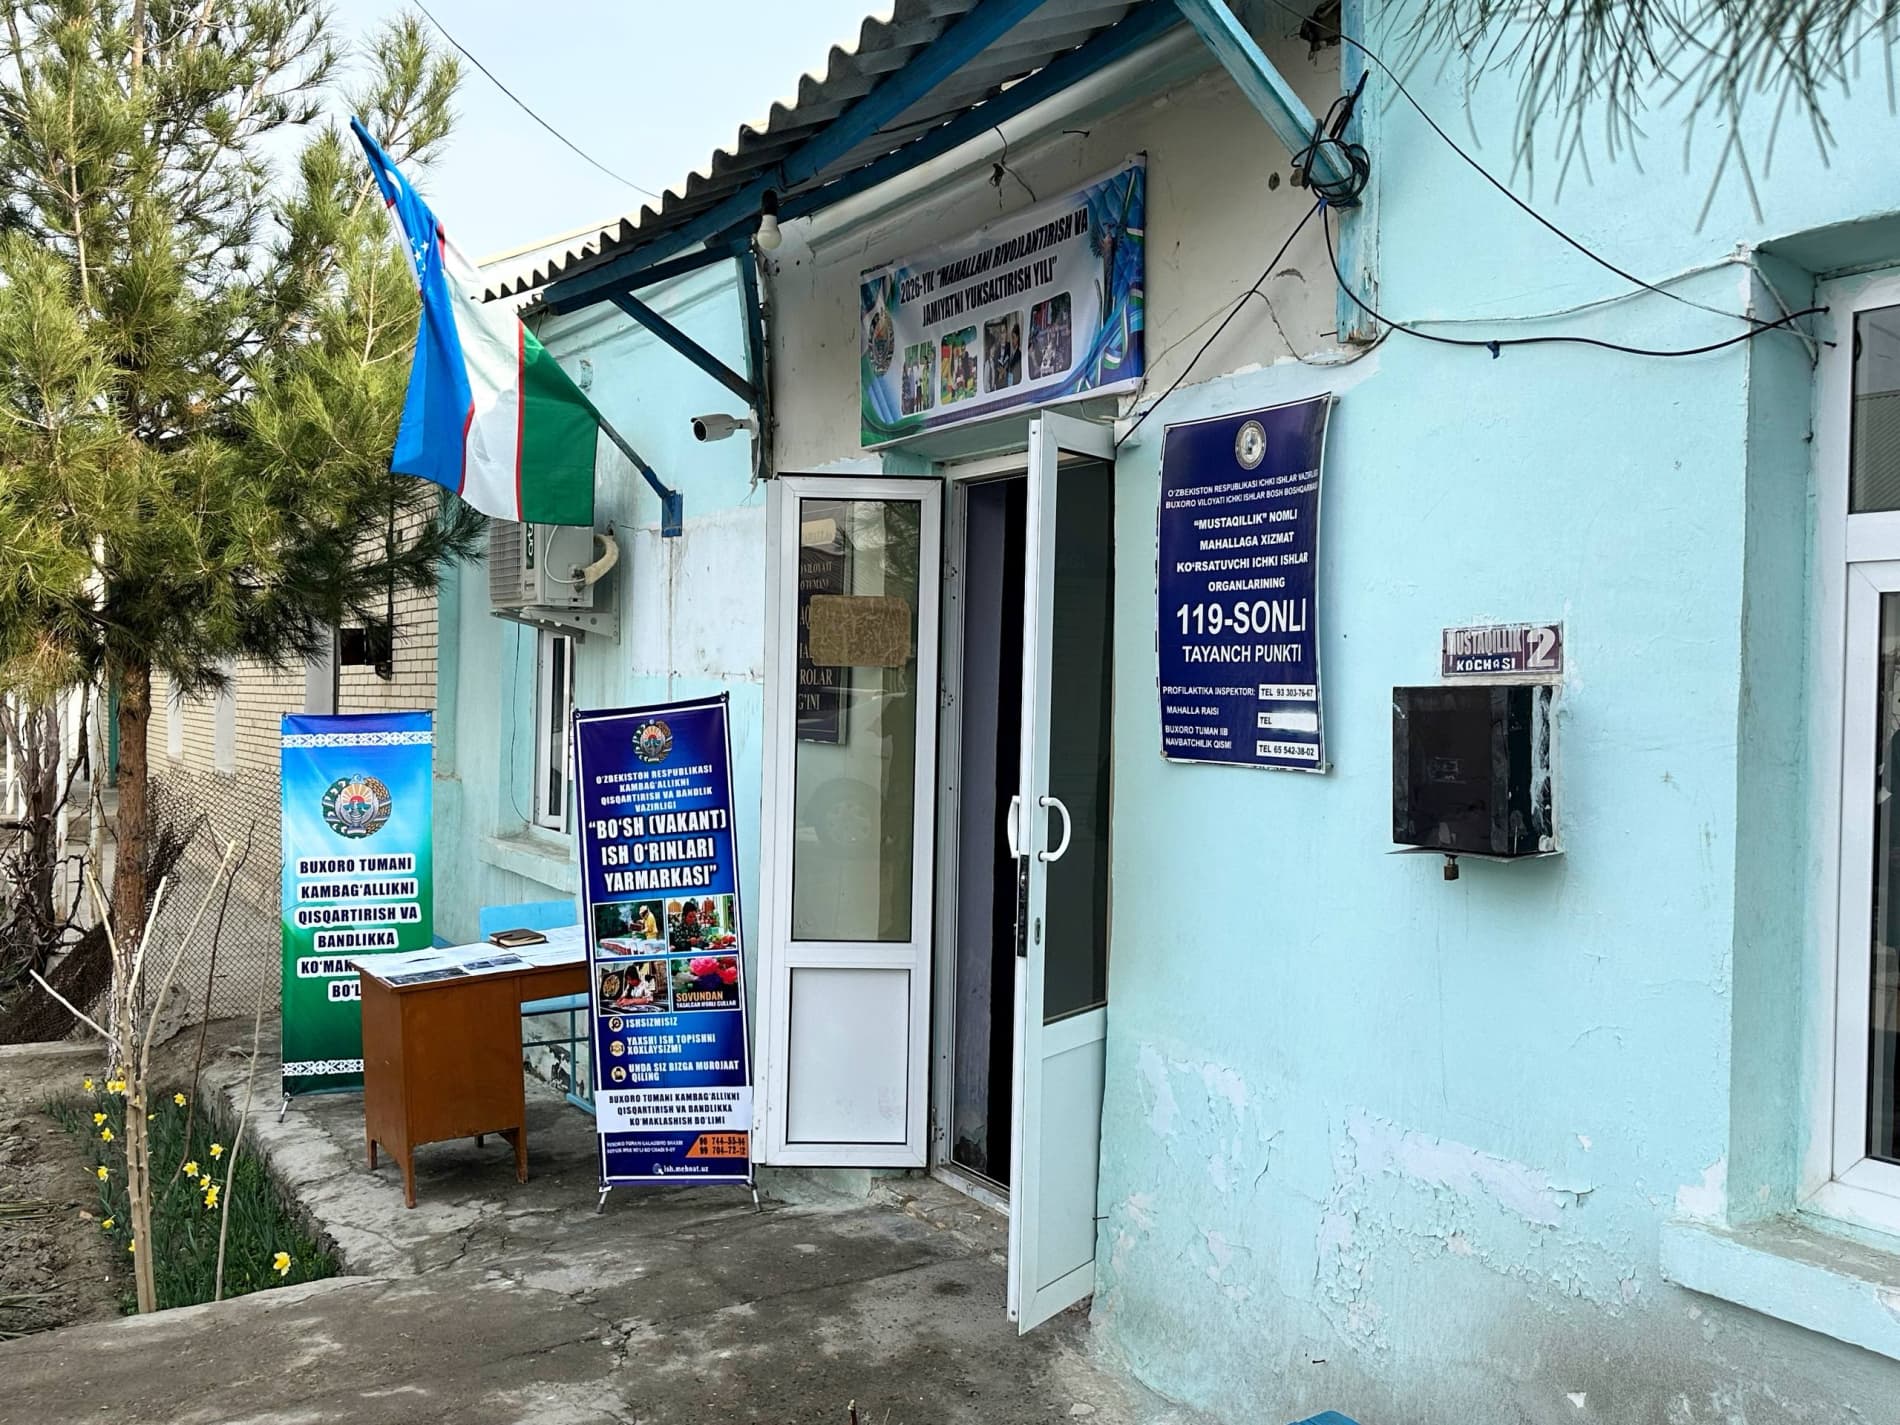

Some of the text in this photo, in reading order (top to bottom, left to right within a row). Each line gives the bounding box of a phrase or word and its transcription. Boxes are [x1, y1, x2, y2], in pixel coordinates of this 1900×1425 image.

[901, 271, 934, 304] 2026-YIL
[992, 214, 1072, 269] RIVOJLANTIRISH
[1075, 208, 1088, 235] VA
[923, 290, 963, 327] JAMIYATNI
[966, 268, 1031, 310] YUKSALTIRISH
[1214, 481, 1257, 492] RESPUBLIKASI
[1259, 478, 1274, 486] ICHKI
[1276, 475, 1297, 485] ISHLAR
[1166, 499, 1196, 508] BUXORO
[1198, 496, 1224, 506] VILOYATI
[1226, 494, 1242, 503] ICHKI
[1244, 492, 1265, 502] ISHLAR
[1266, 489, 1283, 498] BOSH
[1269, 508, 1297, 522] NOMLI
[1200, 532, 1294, 550] MAHALLAGA XIZMAT
[1252, 556, 1277, 568] ICHKI
[1281, 552, 1308, 566] ISHLAR
[1208, 577, 1285, 592] ORGANLARINING
[1177, 598, 1306, 635] 119-SONLI
[1446, 629, 1522, 656] MUSTAQILLIK
[1526, 628, 1556, 668] 2
[1182, 644, 1301, 662] TAYANCH PUNKTI
[1262, 688, 1273, 696] TEL
[1277, 689, 1284, 697] 93
[1167, 706, 1219, 715] MAHALLA RAISI
[1165, 725, 1193, 734] BUXORO
[1195, 726, 1218, 735] TUMAN
[1166, 738, 1212, 748] NAVBATCHILIK
[1259, 745, 1271, 753] TEL
[1274, 746, 1282, 754] 65
[652, 765, 712, 778] RESPUBLIKASI
[601, 787, 712, 806] QISQARTIRISH VA BANDLIK
[635, 801, 676, 812] VAZIRLIGI
[649, 809, 726, 834] (VAKANT)
[602, 845, 628, 865] ISH
[300, 857, 411, 874] BUXORO TUMANI
[299, 906, 417, 925] QISQARTIRISH VA
[318, 932, 394, 948] BANDLIKKA
[676, 991, 723, 1002] SOVUNDAN
[626, 1017, 678, 1028] ISHSIZMISIZ
[659, 1035, 673, 1044] ISH
[654, 1062, 666, 1072] SIZ
[632, 1072, 659, 1082] QILING
[609, 1094, 640, 1103] BUXORO
[643, 1093, 674, 1102] TUMANI
[618, 1104, 732, 1115] QISQARTIRISH VA BANDLIKKA
